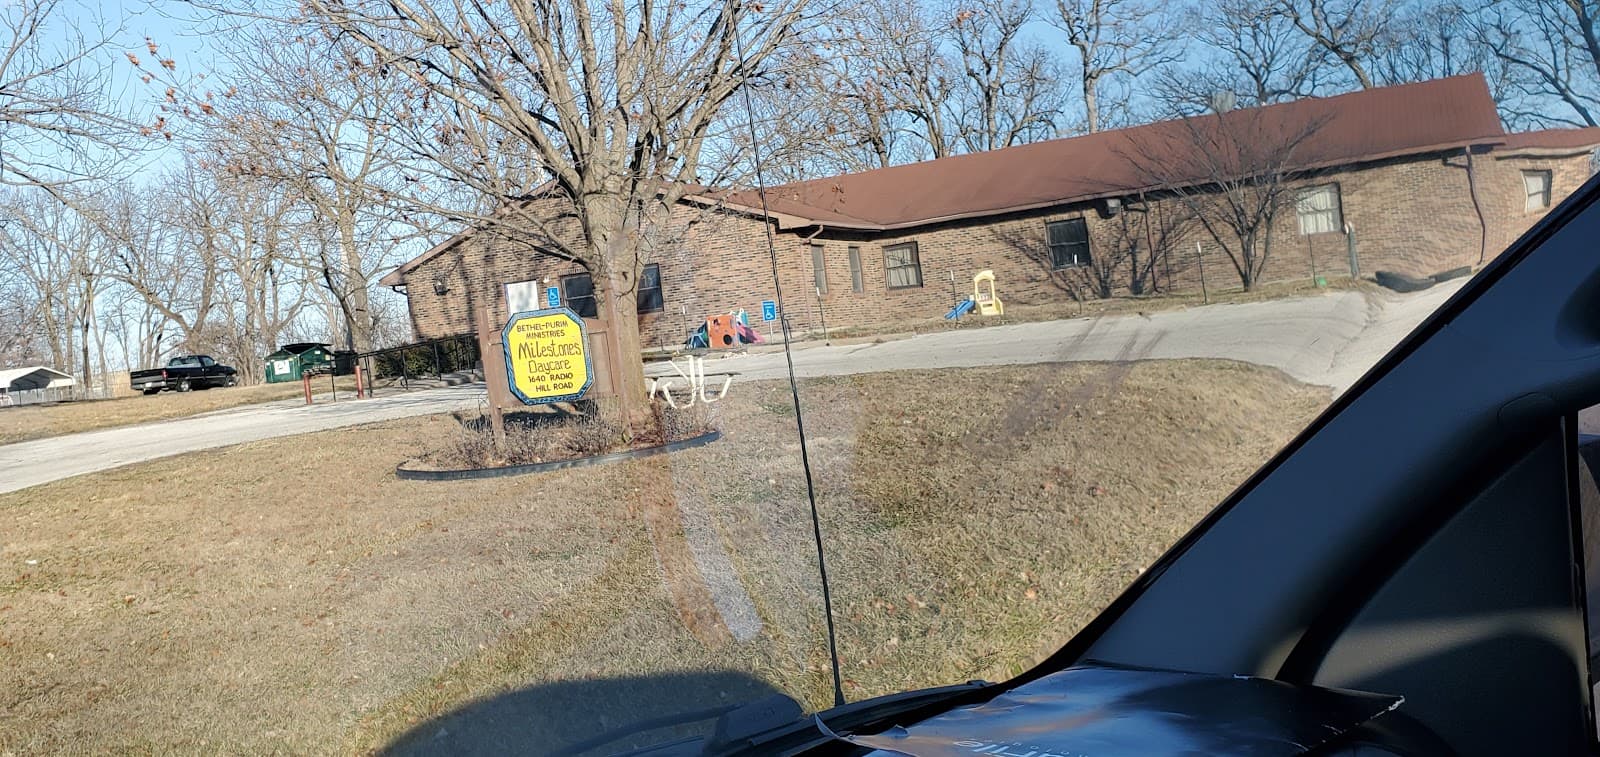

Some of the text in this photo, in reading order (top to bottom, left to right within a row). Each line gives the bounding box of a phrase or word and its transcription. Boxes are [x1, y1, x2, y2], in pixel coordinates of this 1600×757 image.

[526, 330, 565, 339] MINISTRIES
[519, 340, 581, 360] Milestones
[528, 360, 571, 374] Daycare
[528, 372, 573, 383] 1640 RADIO
[536, 382, 573, 392] HILL ROAD
